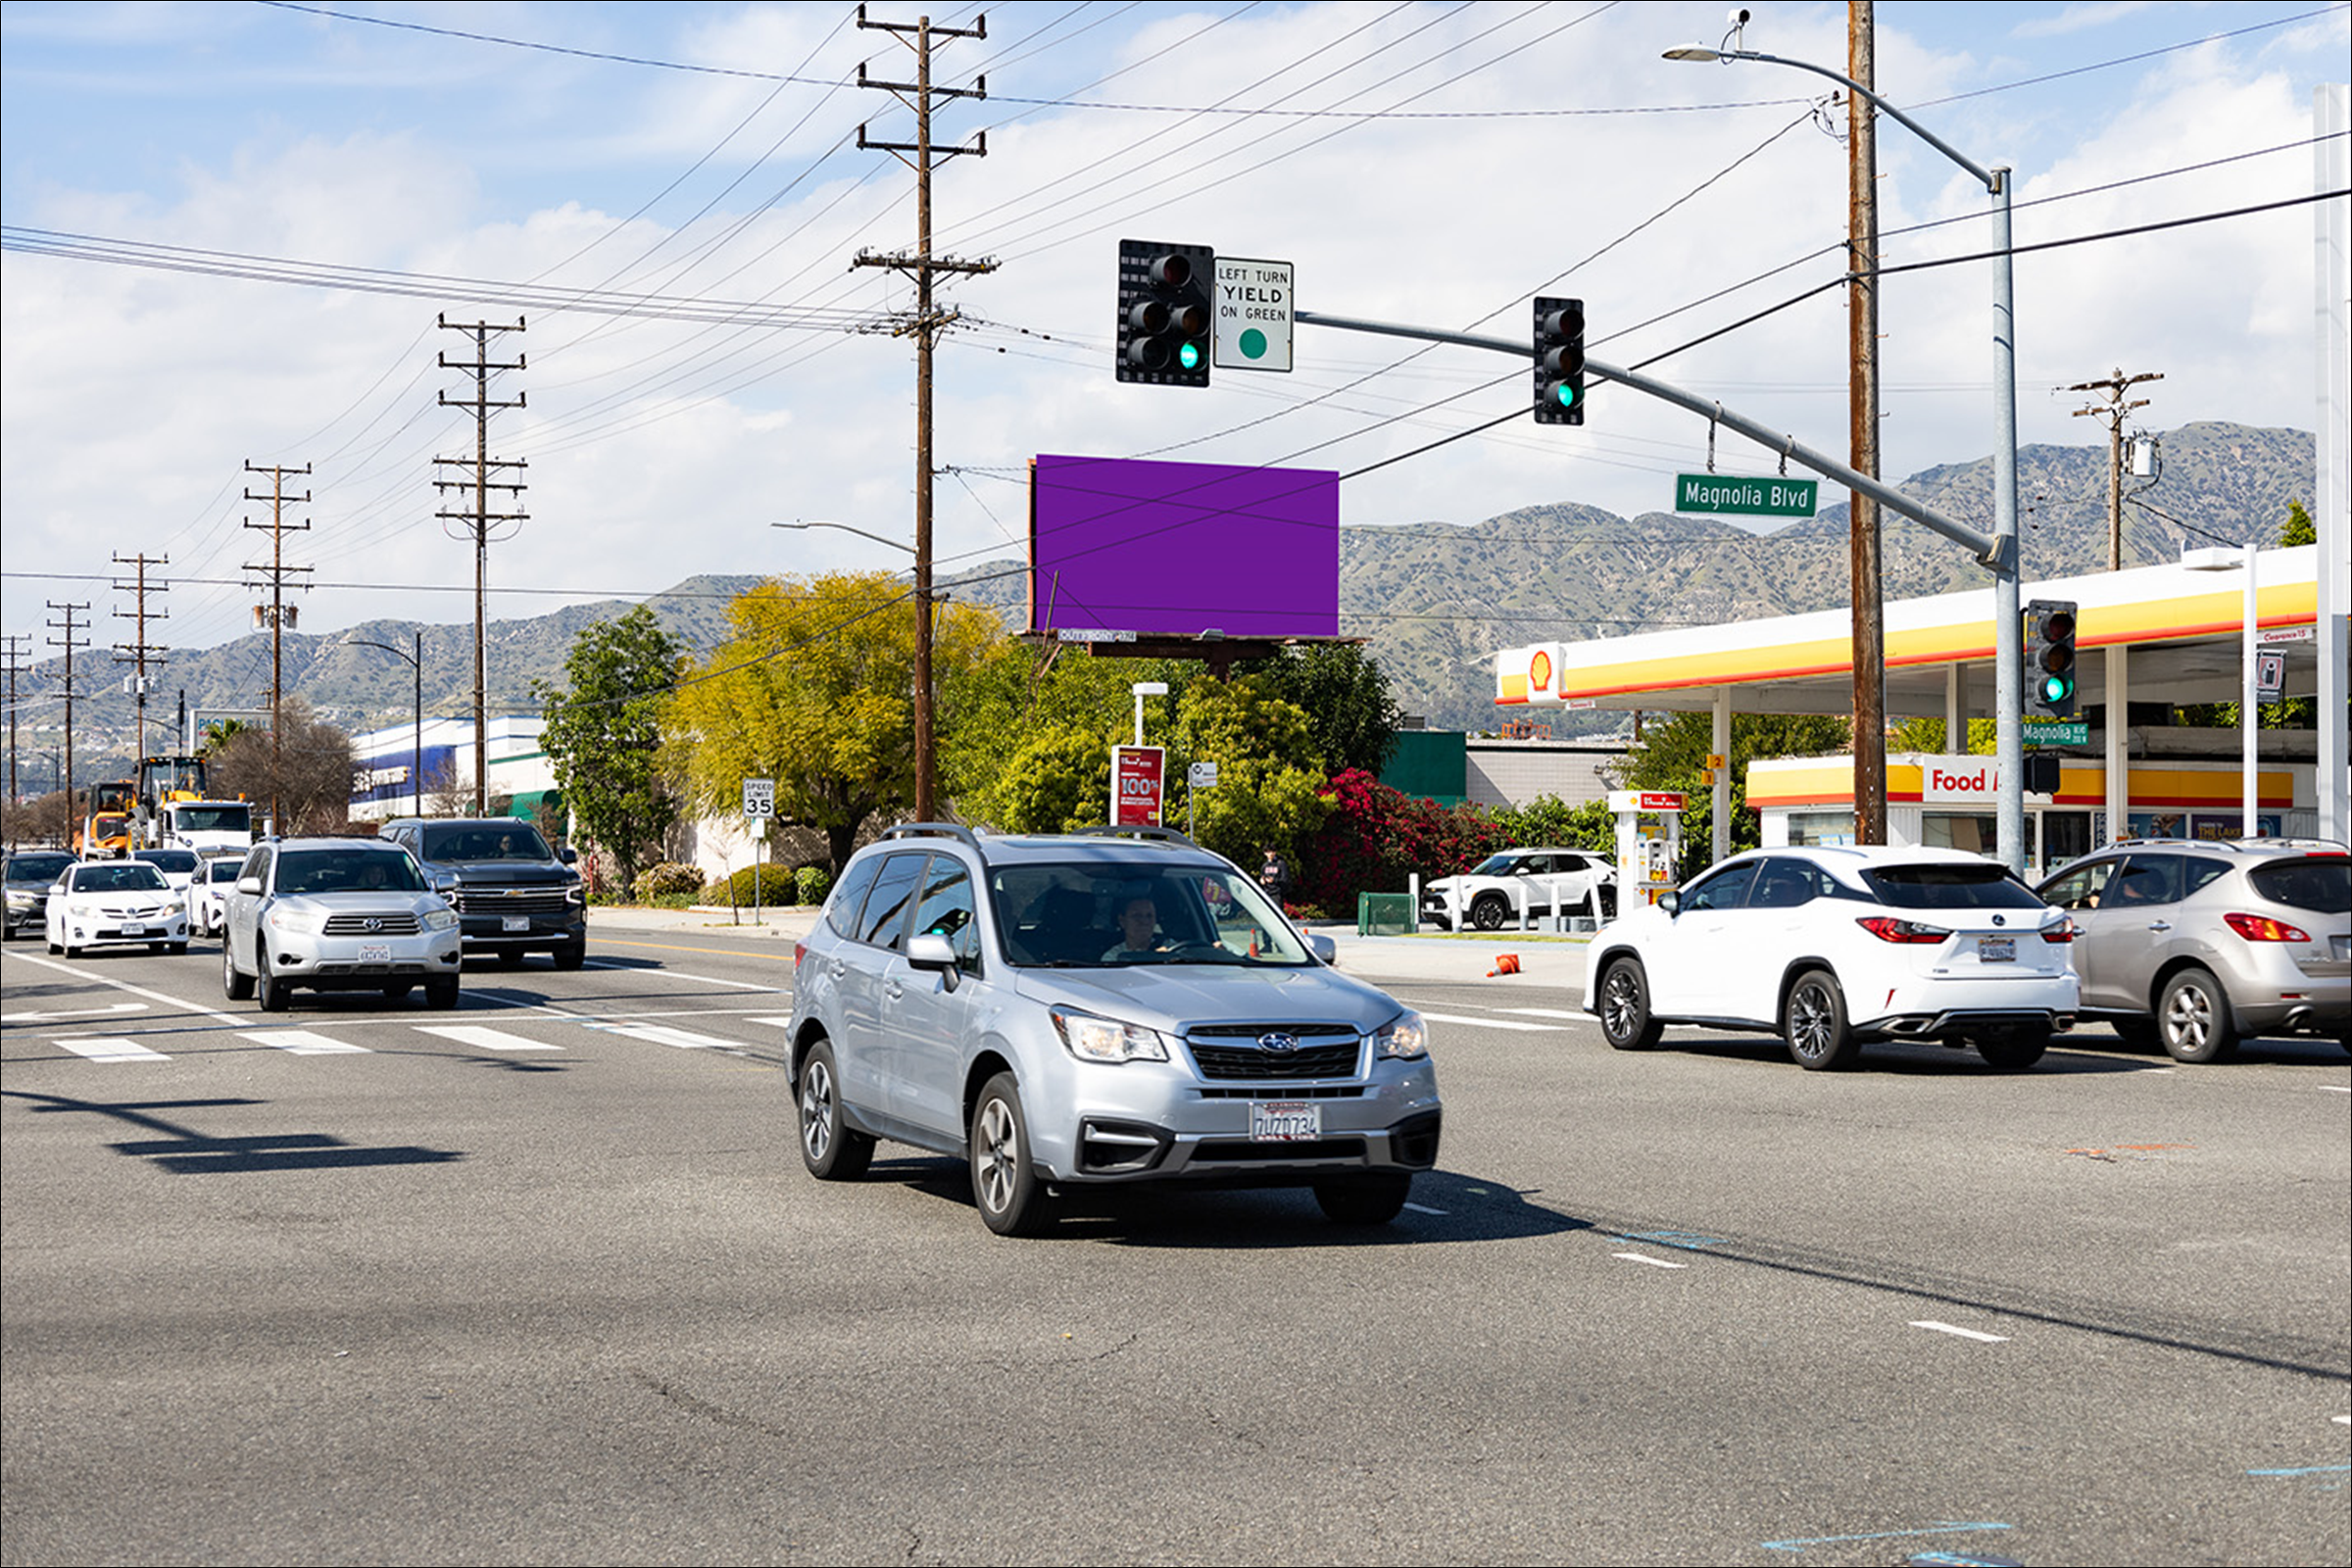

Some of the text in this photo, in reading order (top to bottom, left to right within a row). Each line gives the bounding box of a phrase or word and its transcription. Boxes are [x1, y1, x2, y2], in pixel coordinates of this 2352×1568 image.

[1218, 268, 1288, 283] LEFT TURN
[1223, 285, 1282, 303] YIELD
[1220, 305, 1286, 321] ON GREEN
[1685, 481, 1808, 511] Magnolia Blvd
[2023, 724, 2071, 744] Magnolia
[1714, 757, 1722, 766] 2
[1121, 778, 1158, 796] 100%
[1707, 774, 1712, 783] 1
[1933, 768, 1985, 792] Food
[747, 799, 771, 814] 35
